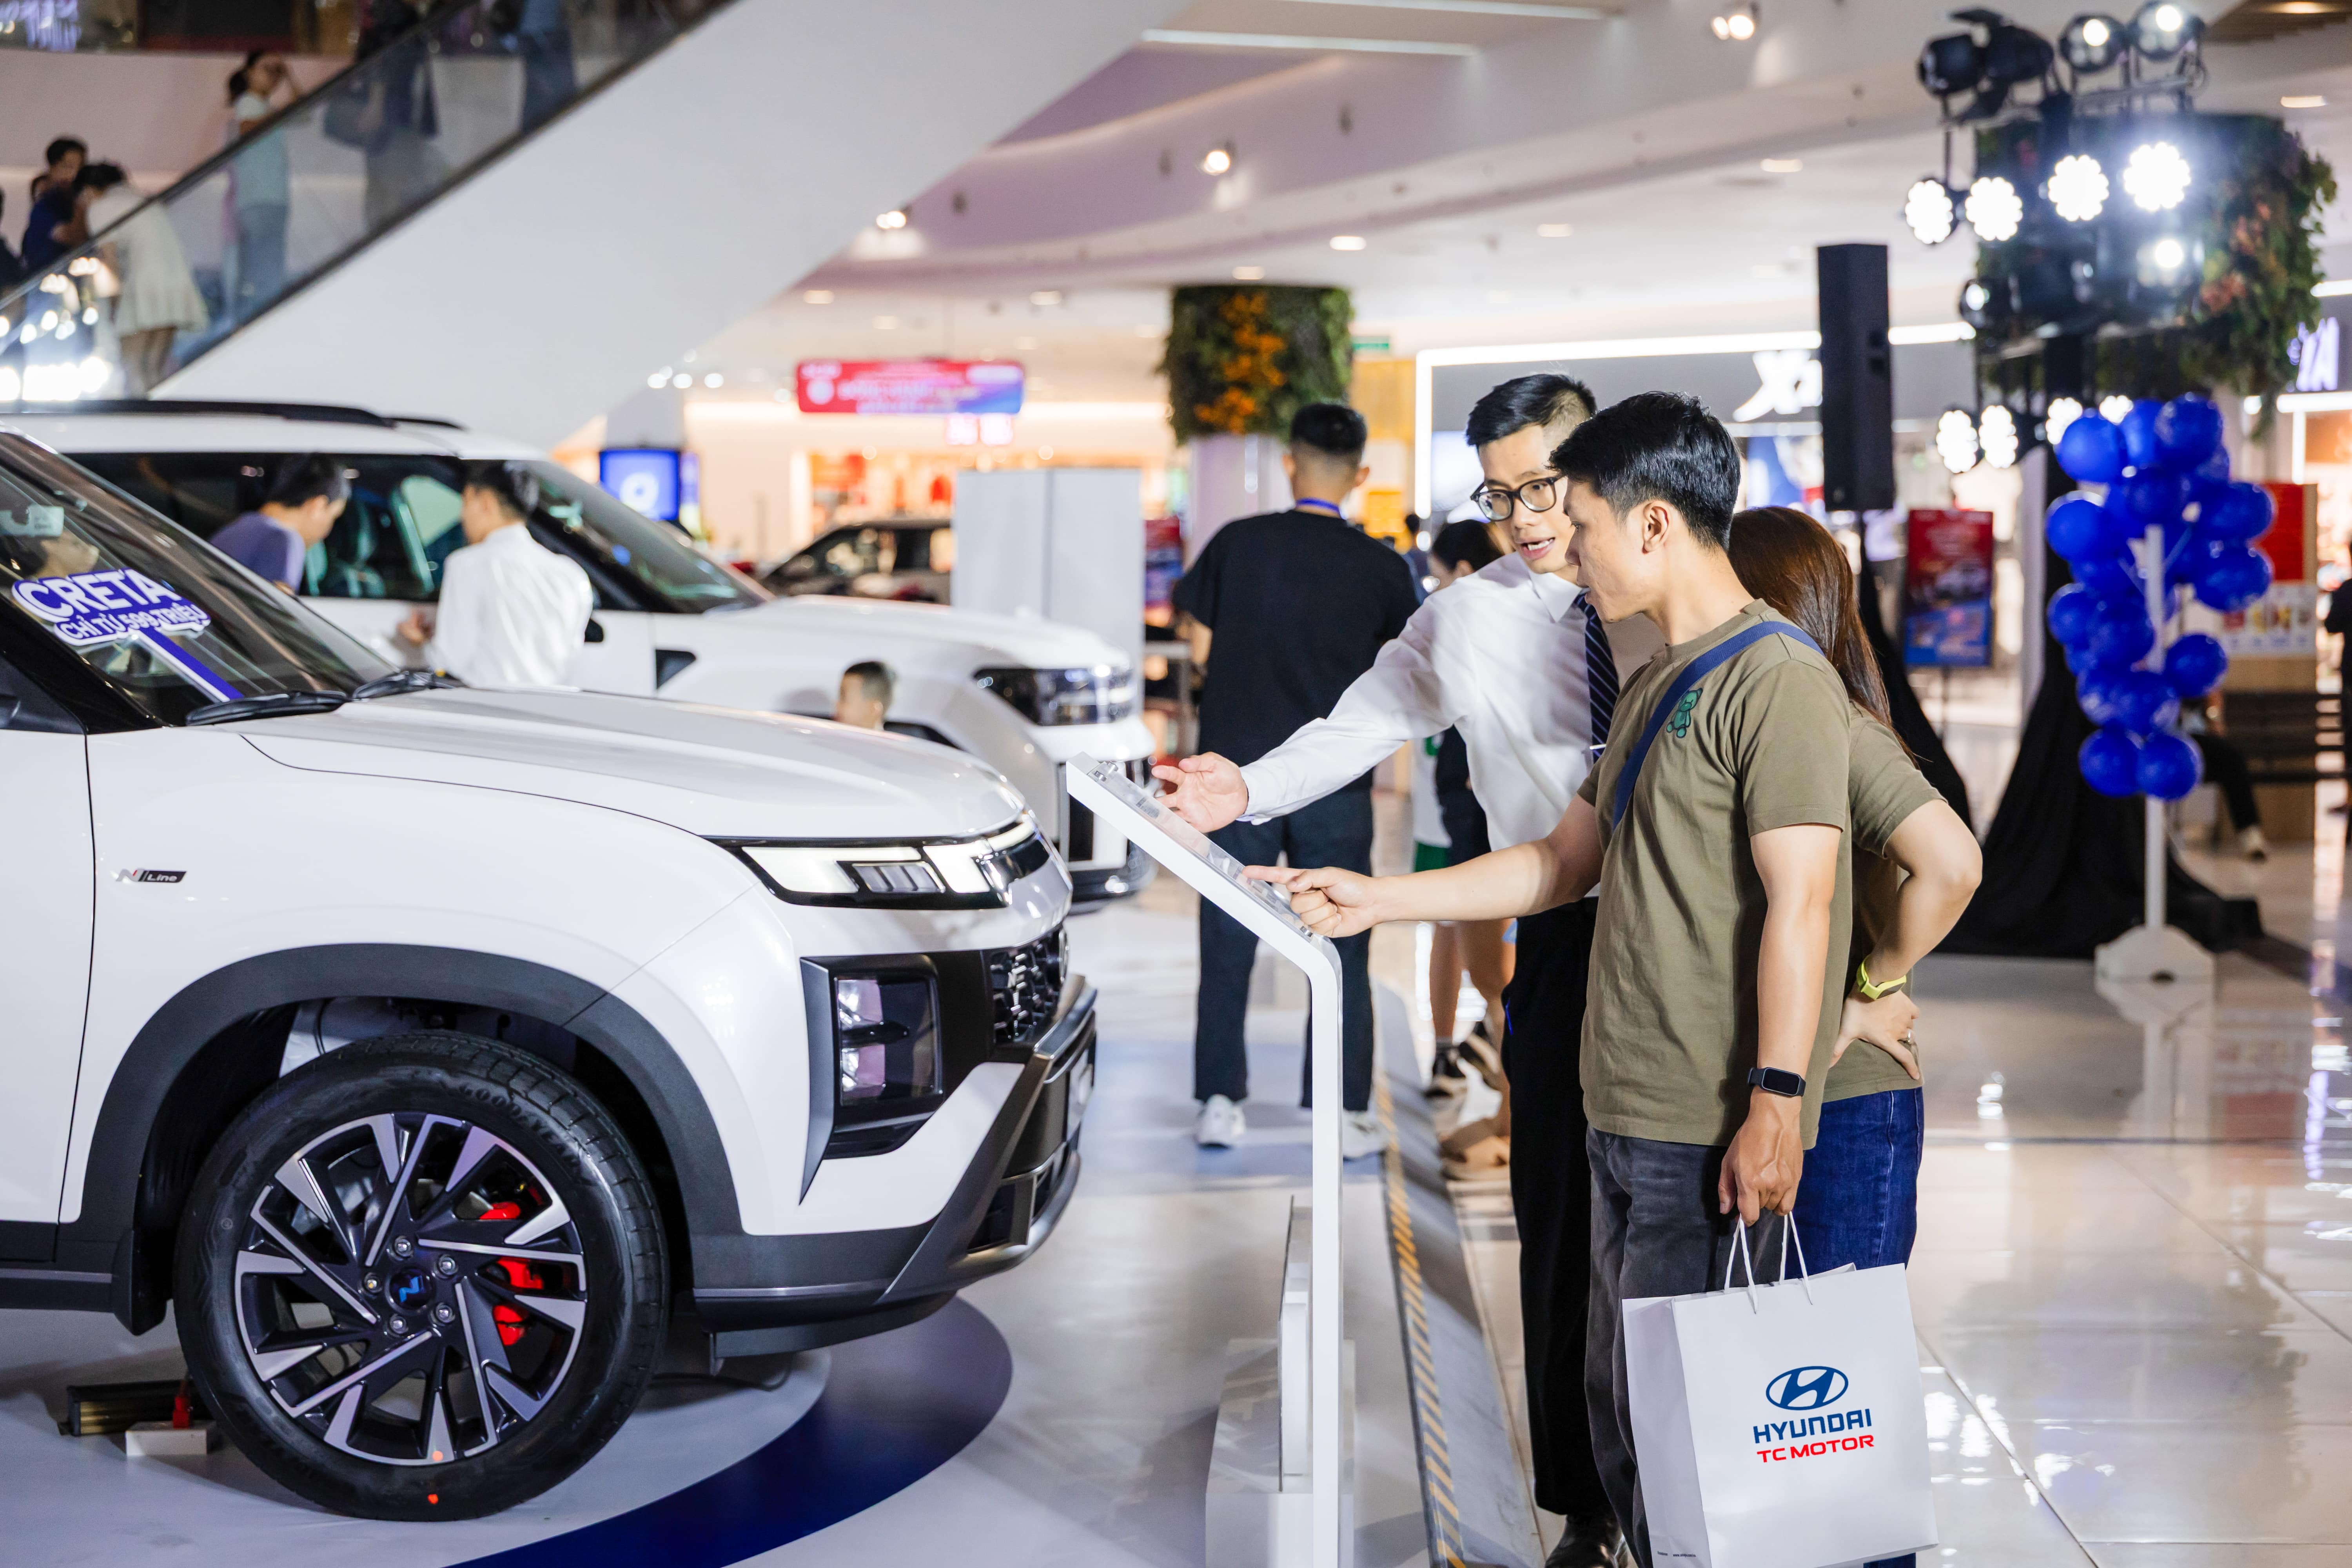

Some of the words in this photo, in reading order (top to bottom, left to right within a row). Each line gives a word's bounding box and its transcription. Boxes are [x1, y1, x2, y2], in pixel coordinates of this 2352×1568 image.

[19, 568, 182, 617] CRETA
[60, 615, 103, 639] CHỈ
[117, 611, 160, 630] 599
[1753, 1409, 1872, 1444] HYUNDAI
[1757, 1448, 1787, 1463] TC
[1790, 1434, 1874, 1459] MOTOR
